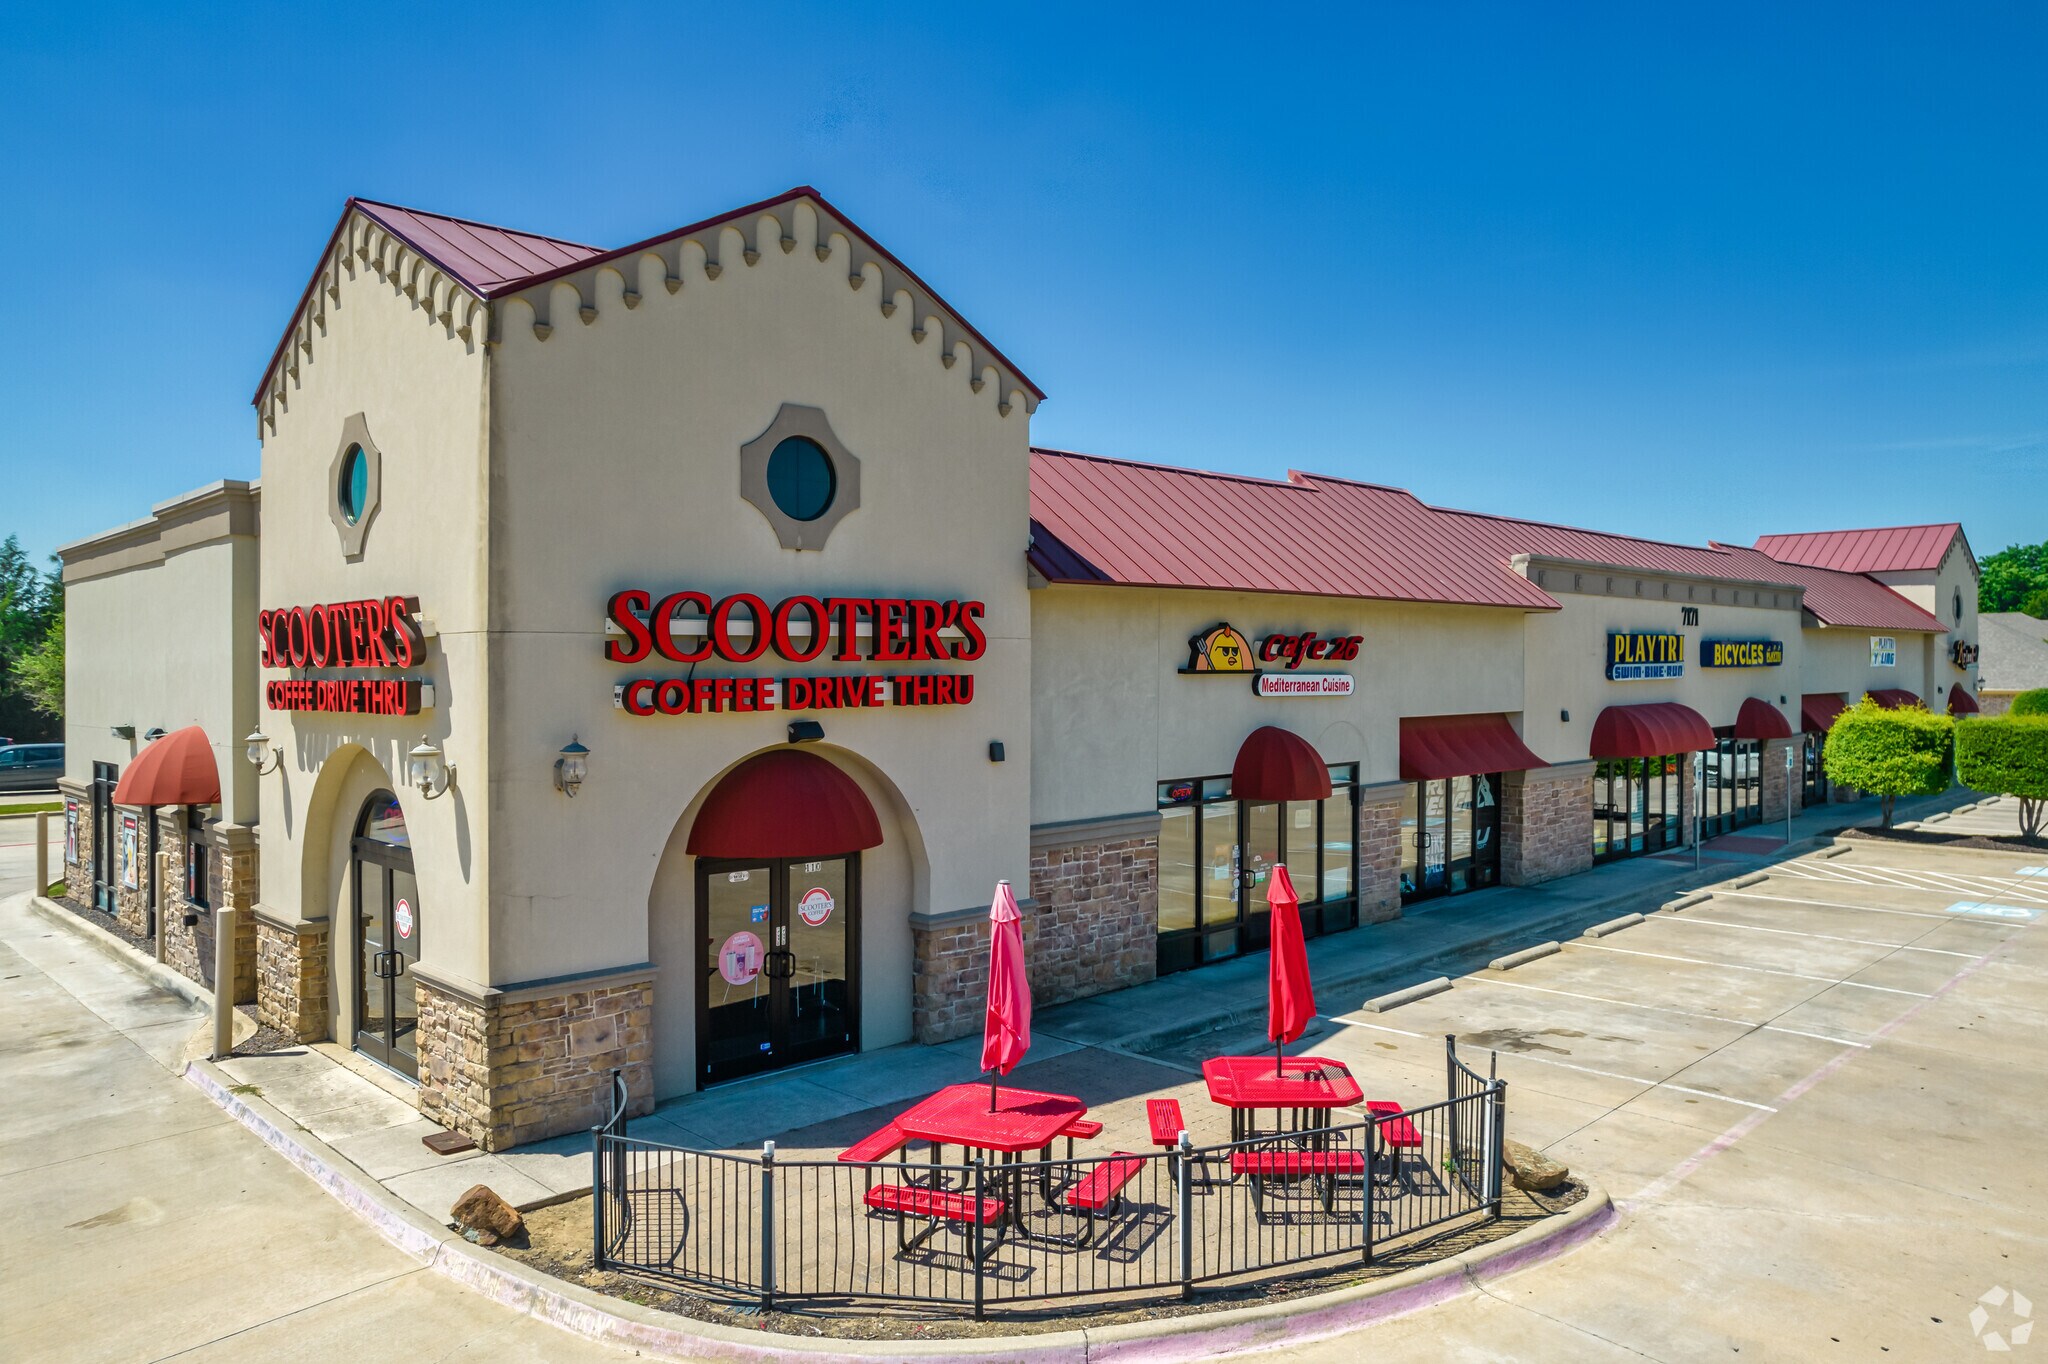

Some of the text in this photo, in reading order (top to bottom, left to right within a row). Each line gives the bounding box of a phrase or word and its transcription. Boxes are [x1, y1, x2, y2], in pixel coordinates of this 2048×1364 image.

[259, 596, 414, 668] SCOOTER'S
[605, 590, 987, 663] SCOOTER'S
[1260, 632, 1364, 670] Cafe 26
[1615, 635, 1685, 663] PLAYTRI
[1714, 643, 1764, 666] BICYCLES
[266, 680, 408, 717] COFFEE DRIVE THRU
[622, 674, 975, 716] COFFEE DRIVE THRU
[1261, 677, 1350, 693] Mediterranean Cuisine
[1172, 788, 1192, 799] OPEN
